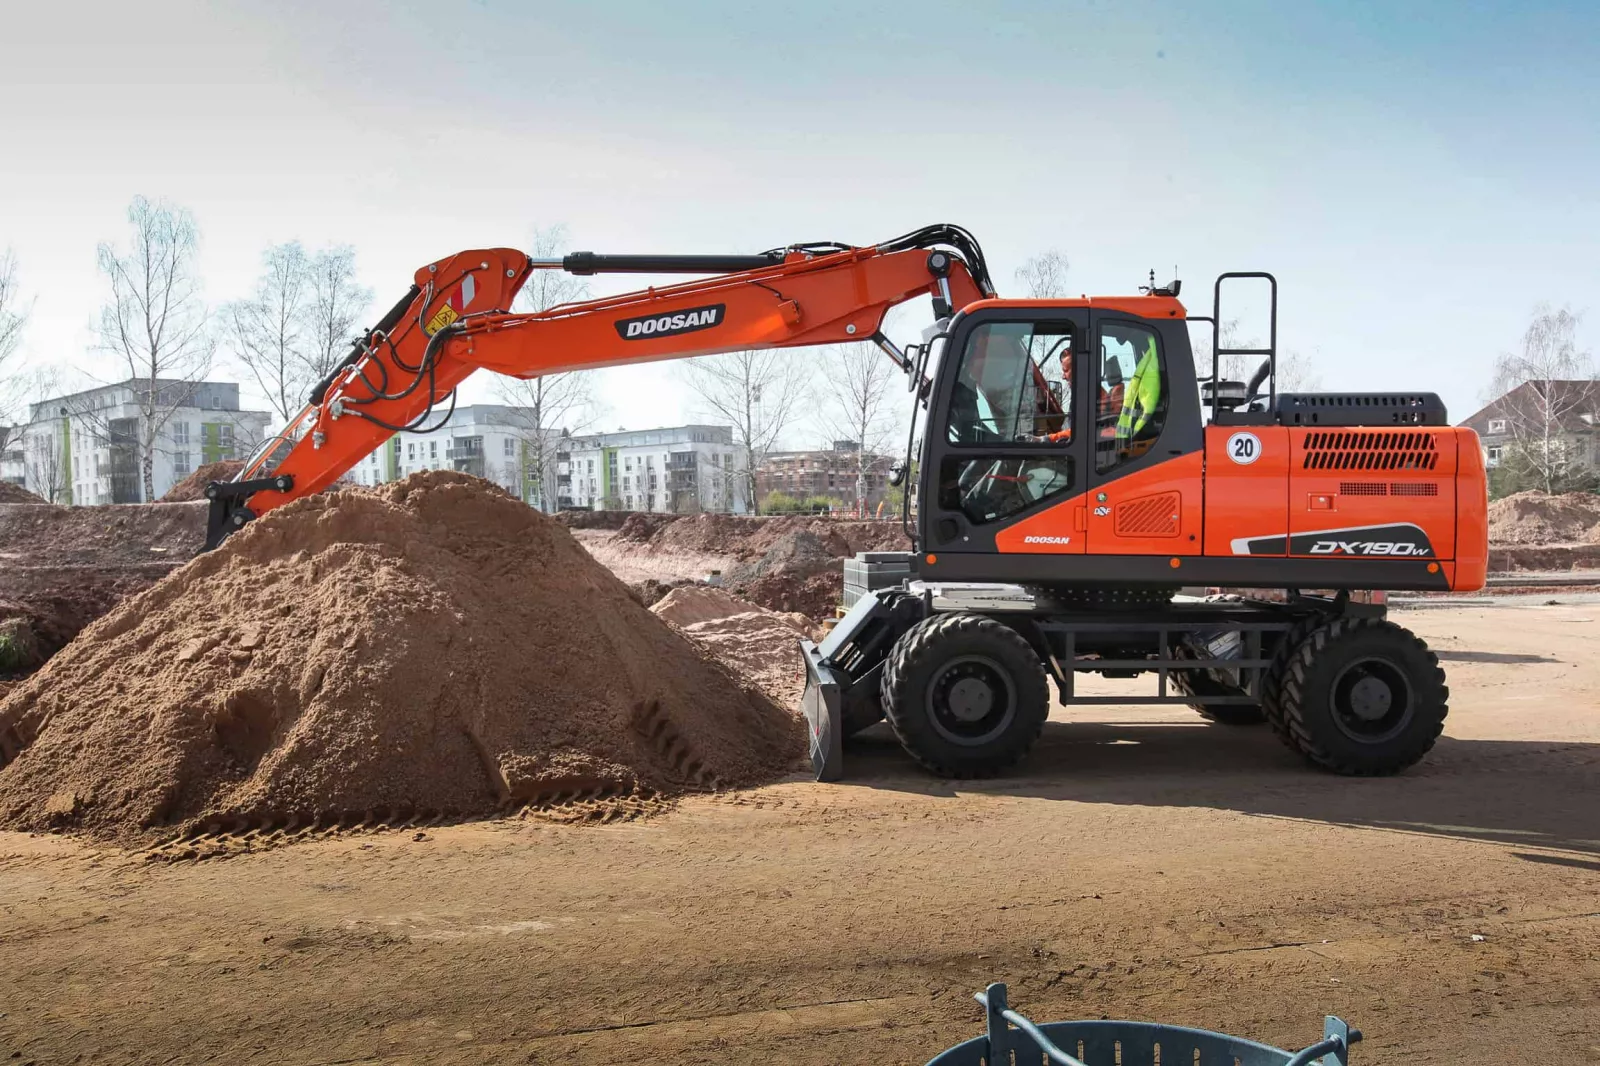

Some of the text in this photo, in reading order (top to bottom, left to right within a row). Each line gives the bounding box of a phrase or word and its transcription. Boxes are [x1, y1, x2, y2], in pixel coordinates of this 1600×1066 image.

[626, 309, 717, 337] DOOSAN
[1234, 438, 1254, 458] 20
[1024, 536, 1069, 545] DOOSAN
